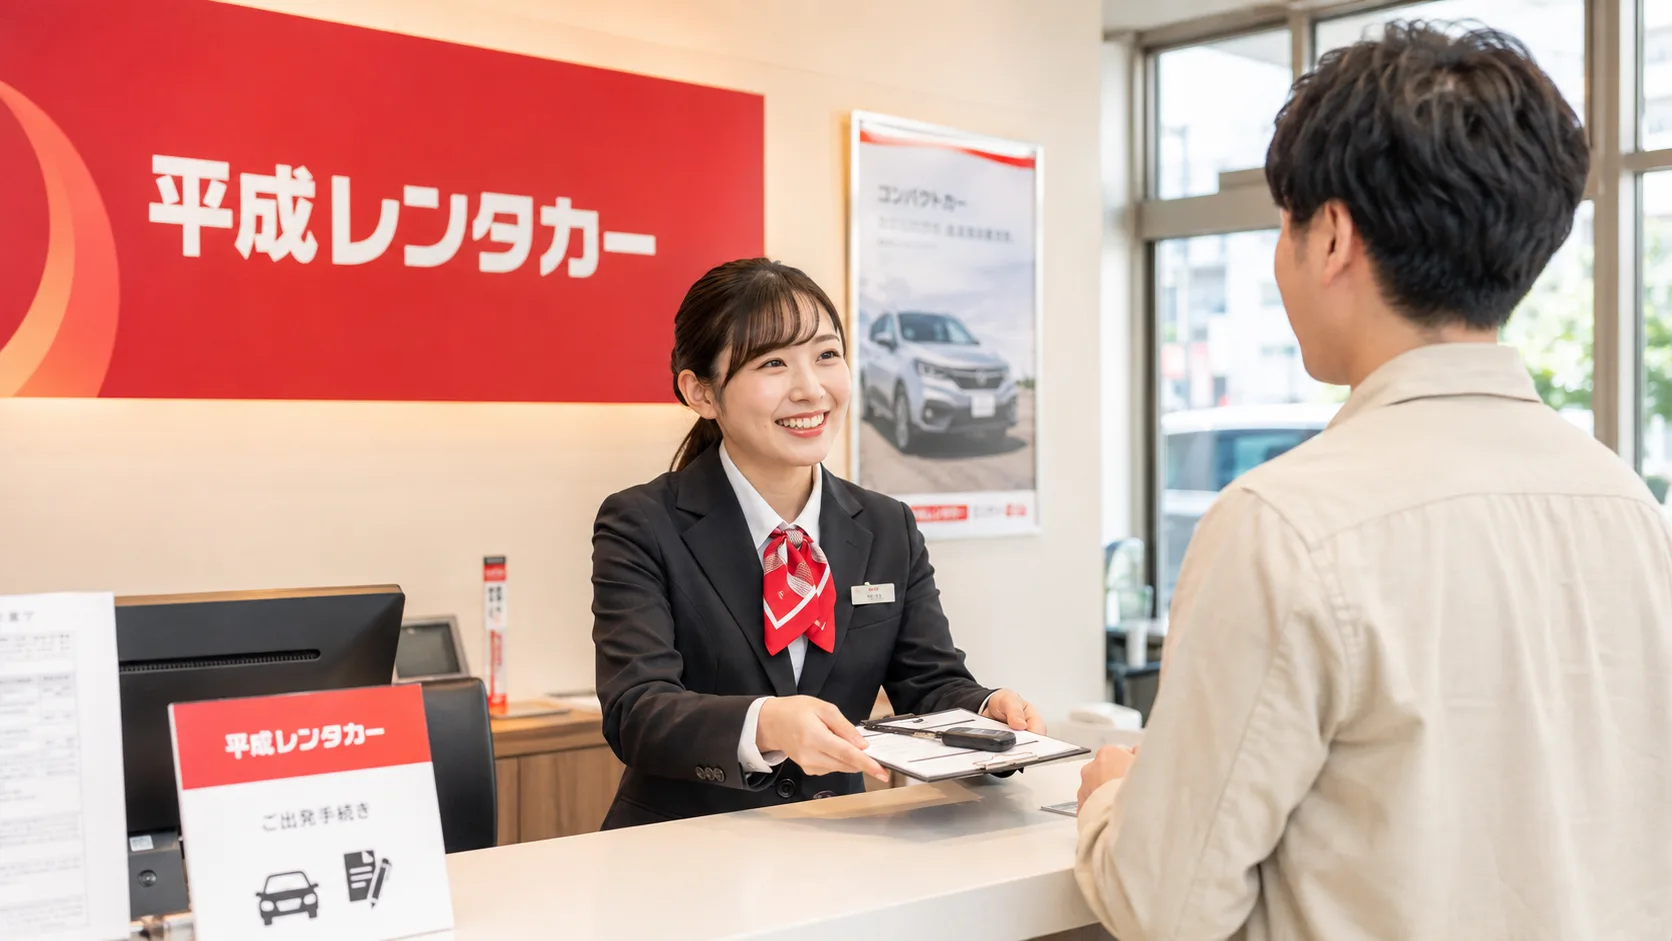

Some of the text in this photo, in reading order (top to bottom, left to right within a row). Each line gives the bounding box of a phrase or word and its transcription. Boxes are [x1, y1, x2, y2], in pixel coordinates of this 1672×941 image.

[149, 155, 656, 278] 平成レンタカー
[224, 722, 386, 760] 平成レンタカー
[262, 802, 370, 832] ご出発手続き
